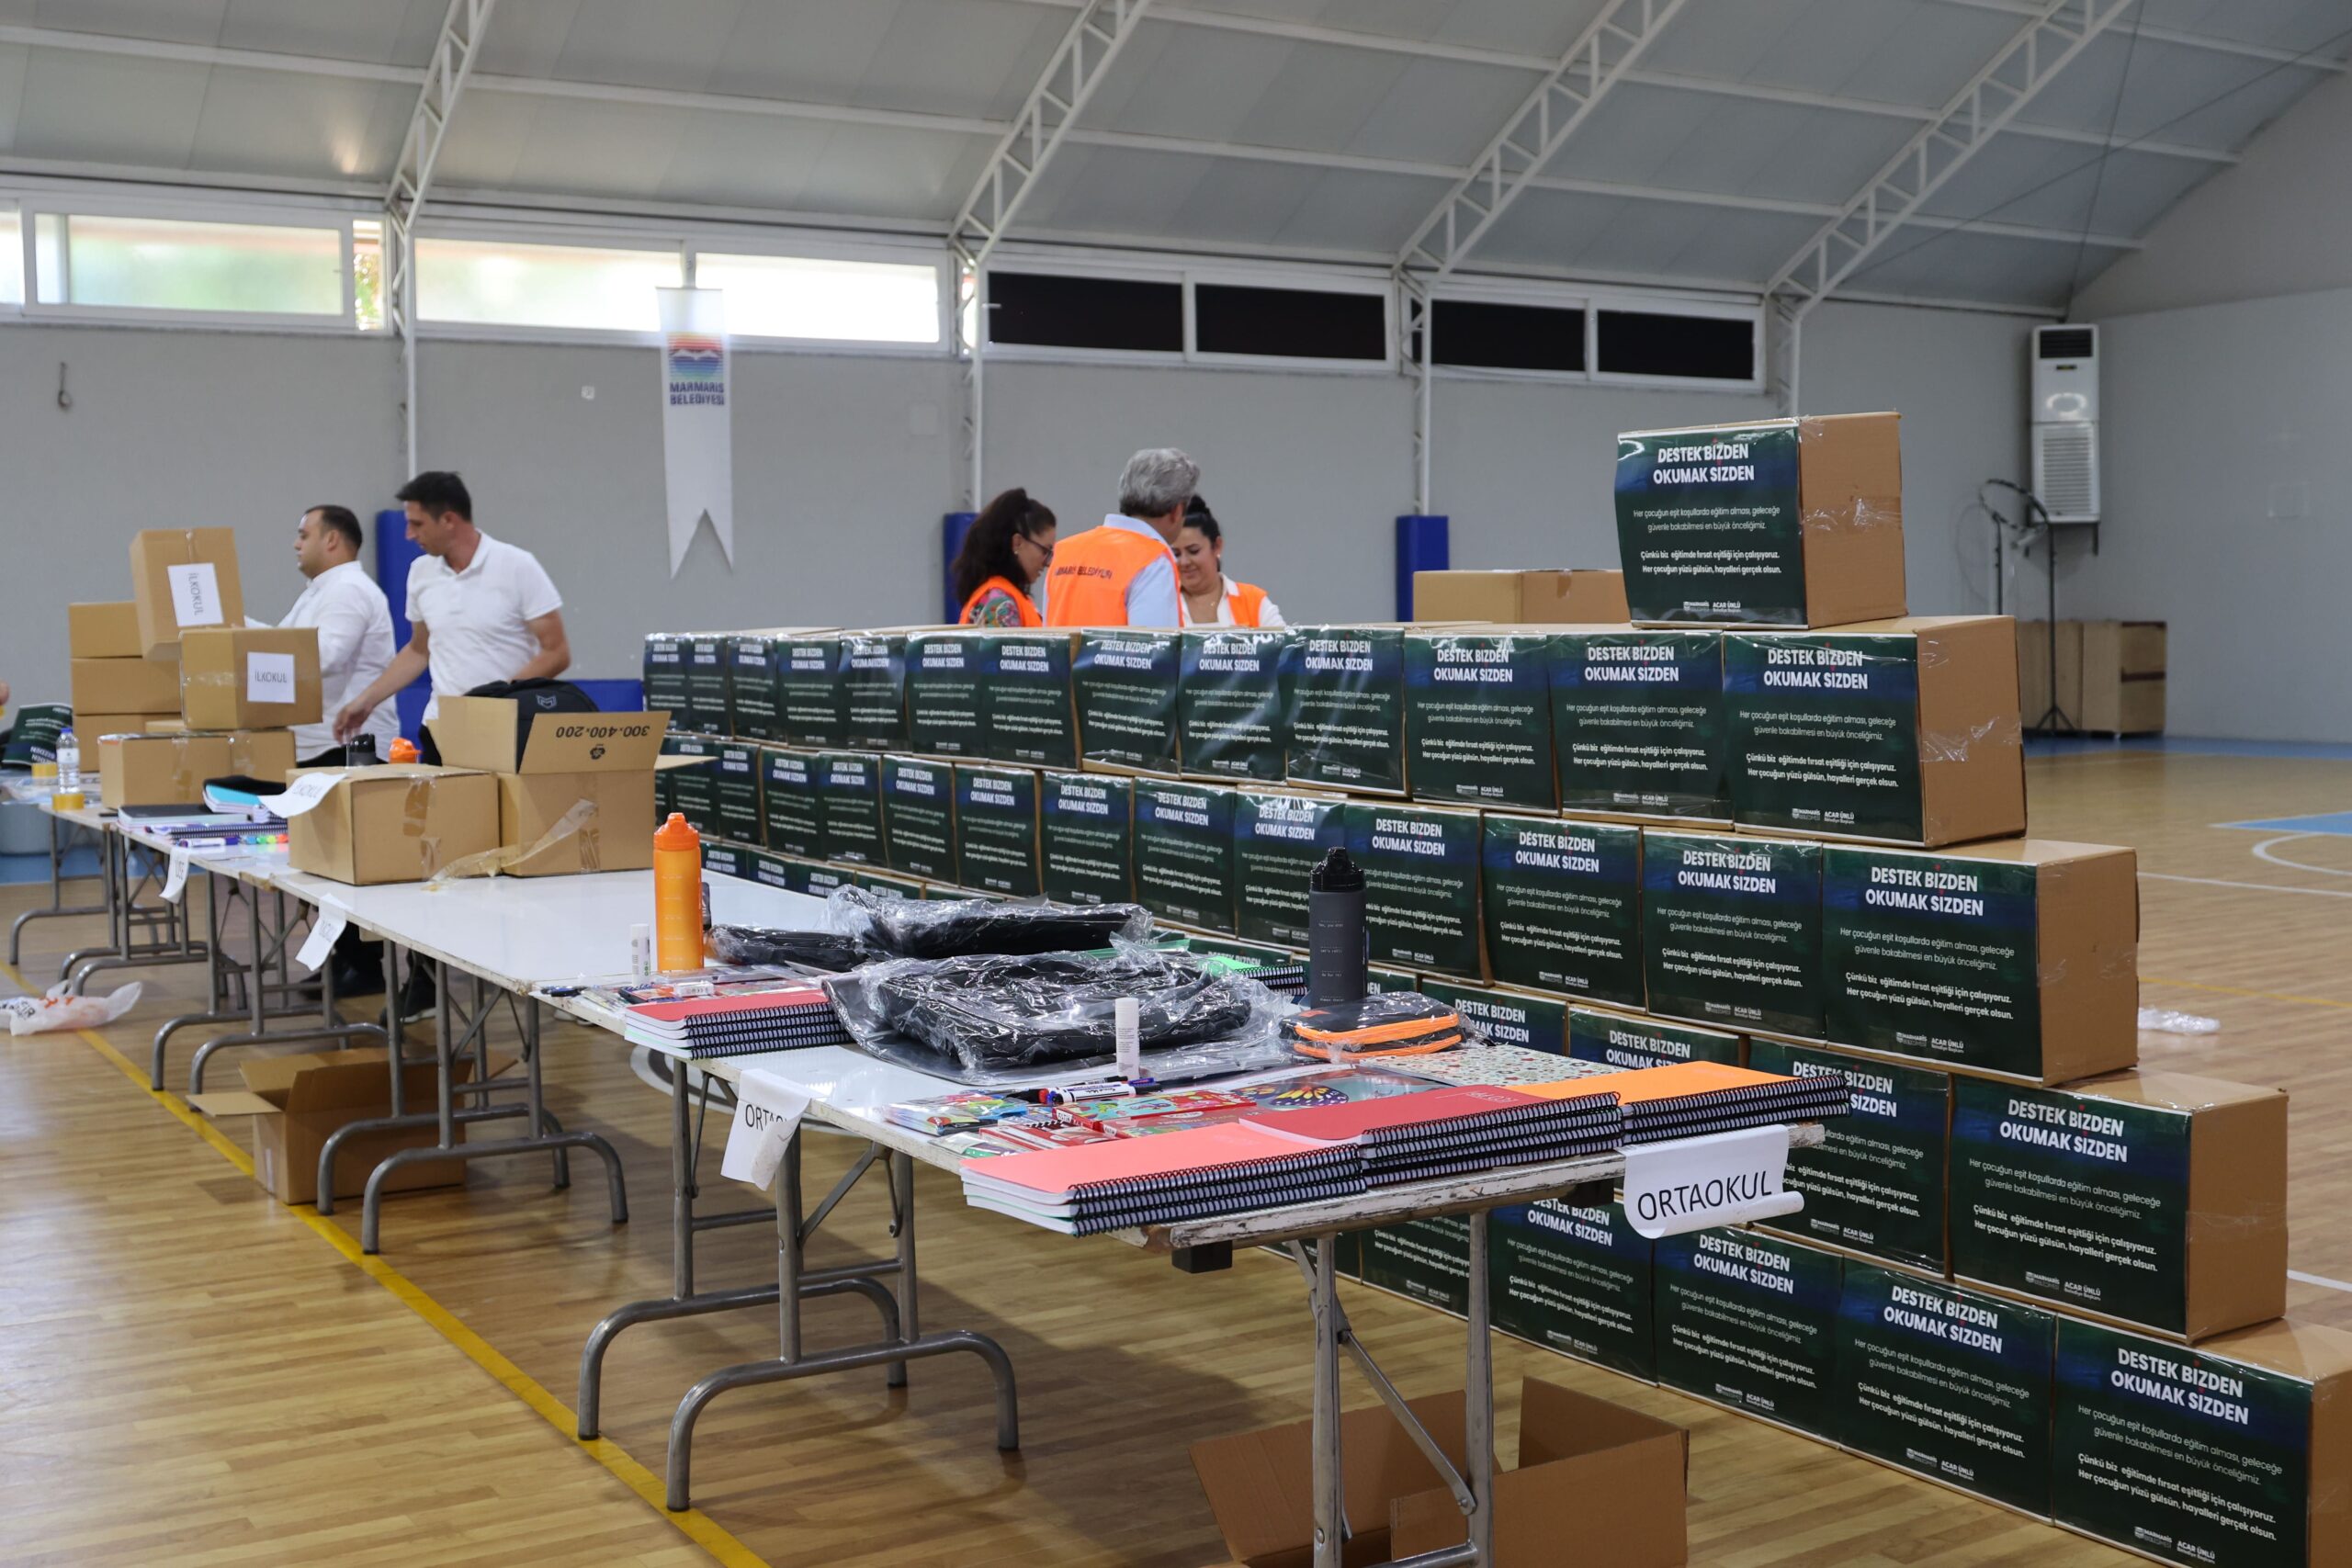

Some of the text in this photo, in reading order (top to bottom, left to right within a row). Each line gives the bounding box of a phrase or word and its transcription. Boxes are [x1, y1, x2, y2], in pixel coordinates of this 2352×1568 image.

[670, 382, 724, 393] MARMARİS
[1658, 446, 1702, 463] DESTEK
[1653, 468, 1707, 484] OKUMAK
[1588, 647, 1631, 661] DESTEK
[1769, 649, 1815, 666] DESTEK
[1584, 667, 1636, 682] OKUMAK
[1763, 671, 1821, 688] OKUMAK
[1519, 831, 1556, 849] DESTEK
[1515, 851, 1561, 869] OKUMAK
[1683, 850, 1725, 868] DESTEK
[1678, 871, 1731, 890] OKUMAK
[1871, 866, 1924, 887] DESTEK
[1865, 888, 1930, 911] OKUMAK
[1610, 1030, 1648, 1053] DESTEK
[2007, 1099, 2064, 1126] DESTEK
[1999, 1121, 2069, 1151] OKUMAK
[1637, 1170, 1772, 1221] ORTAOKUL
[1700, 1234, 1743, 1259] DESTEK
[1694, 1253, 1747, 1281] OKUMAK
[1892, 1285, 1943, 1314] DESTEK
[1883, 1305, 1949, 1339] OKUMAK
[2118, 1348, 2177, 1381] DESTEK
[2110, 1371, 2185, 1407] OKUMAK
[2077, 1404, 2091, 1415] Her
[2092, 1410, 2125, 1426] çocuğun
[2093, 1427, 2123, 1442] güvenle
[2174, 1451, 2184, 1461] en
[2077, 1452, 2104, 1468] Çünkü
[2105, 1460, 2118, 1472] biz
[2120, 1466, 2156, 1484] eğitimde
[2157, 1476, 2179, 1492] fırsat
[2210, 1493, 2226, 1506] için
[2226, 1501, 2276, 1523] çalışıyoruz.
[2077, 1468, 2276, 1540] Her çocuğun yüzü gülsün, hayalleri gerçek olsun.
